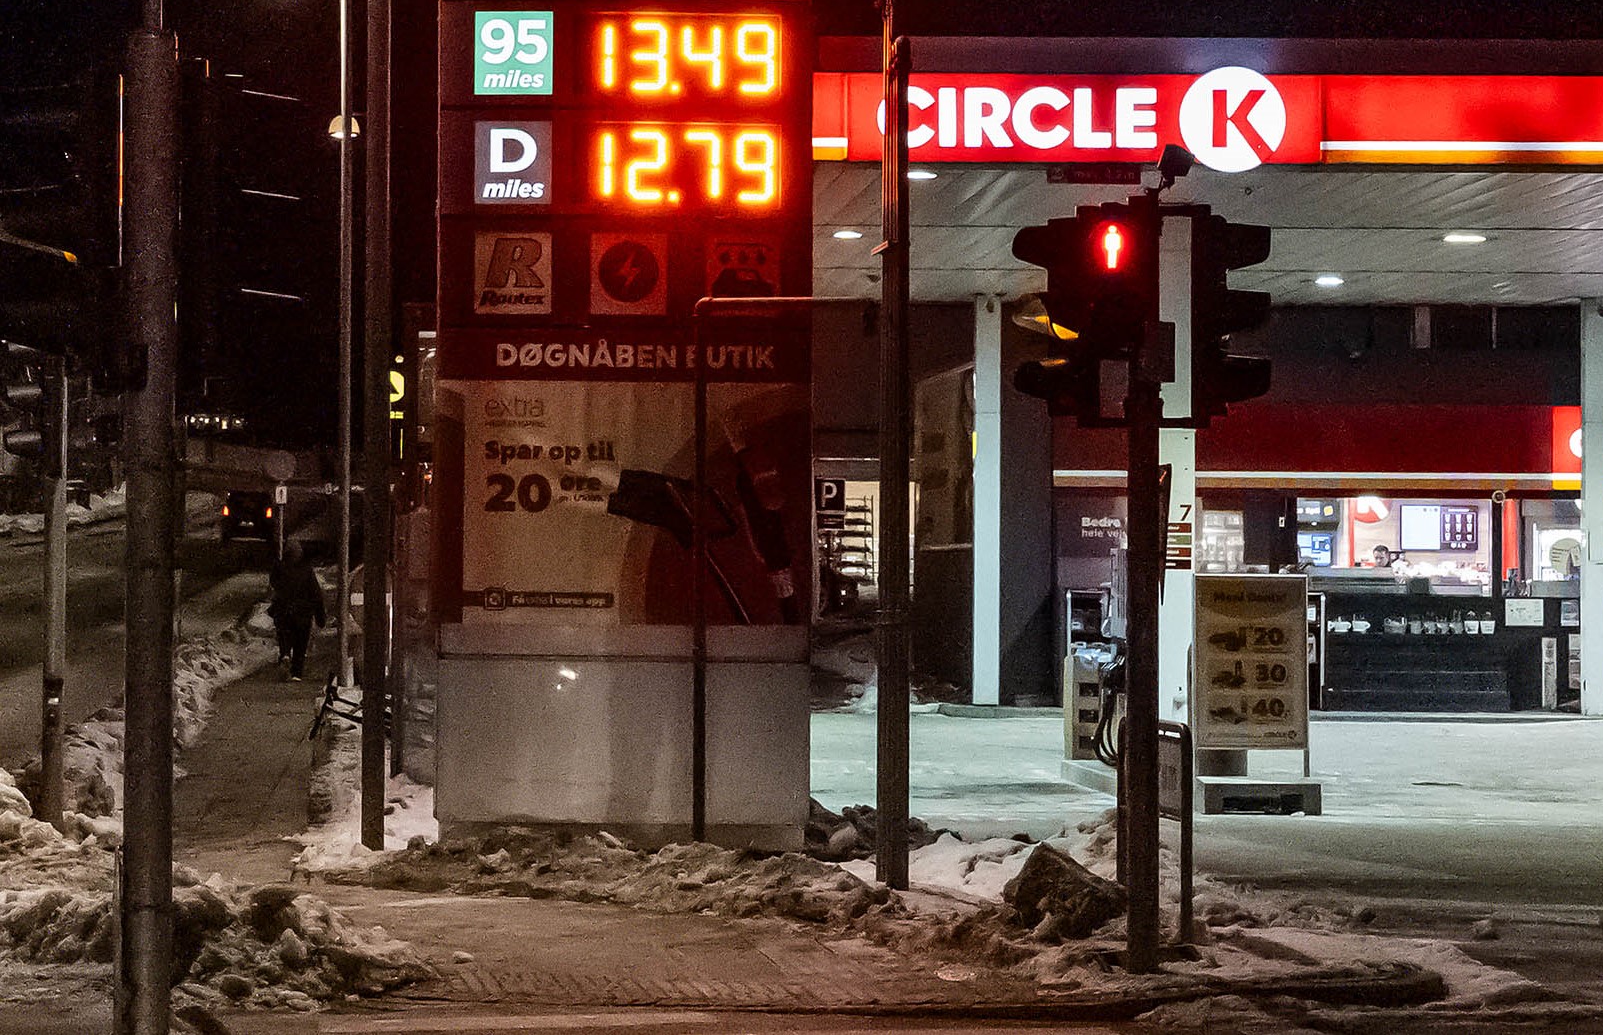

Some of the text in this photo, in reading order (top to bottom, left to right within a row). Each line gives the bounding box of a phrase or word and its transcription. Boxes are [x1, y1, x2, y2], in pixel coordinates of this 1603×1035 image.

[480, 19, 547, 65] 95
[600, 20, 779, 94] 13.49
[483, 70, 544, 89] miles
[489, 128, 538, 173] D
[600, 129, 778, 204] 12.79
[482, 178, 545, 199] miles
[484, 237, 545, 288] R
[496, 338, 677, 368] DØGNÅBEN
[484, 395, 545, 418] extra
[485, 440, 616, 466] Spar op til
[484, 473, 552, 513] 20
[822, 481, 837, 507] P
[1180, 504, 1192, 522] 7
